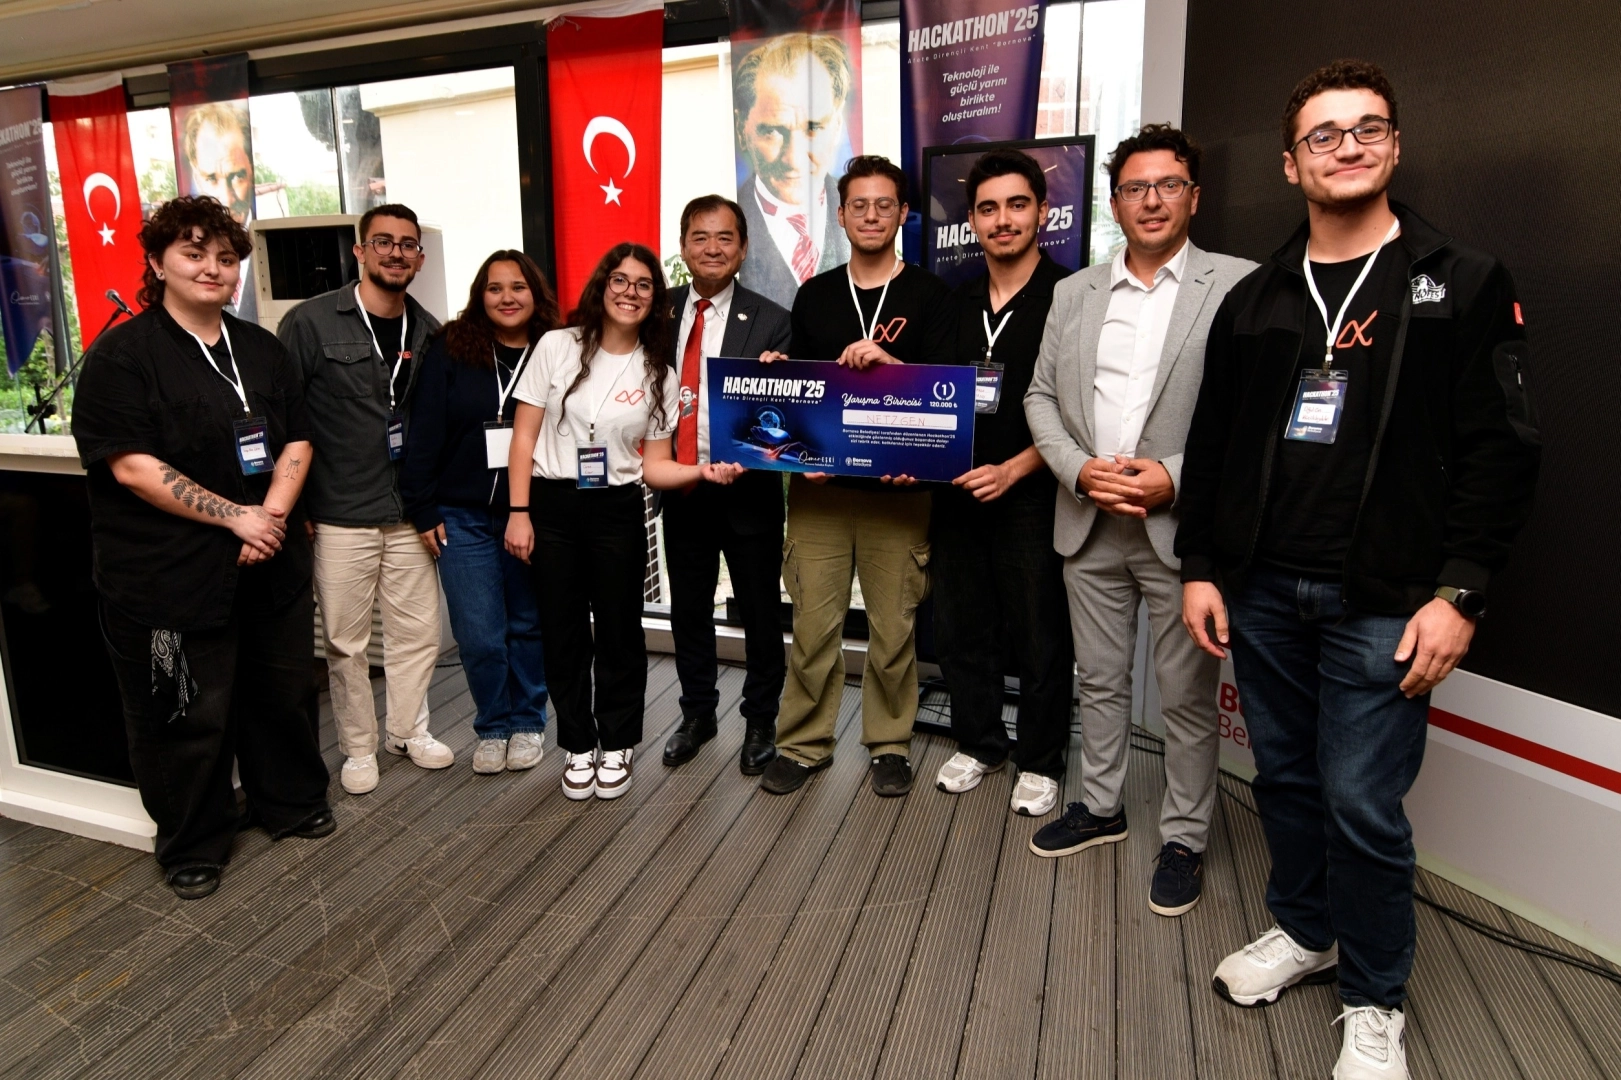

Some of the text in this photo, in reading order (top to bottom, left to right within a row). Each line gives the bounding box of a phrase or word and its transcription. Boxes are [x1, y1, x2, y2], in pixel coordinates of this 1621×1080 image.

[908, 4, 1039, 52] HACKATHON'25
[907, 55, 929, 64] Afete
[933, 48, 966, 60] Dirençli
[970, 44, 989, 52] Kent
[942, 63, 1000, 83] Teknoloji ile
[950, 77, 1007, 97] güçlü yarını
[960, 93, 995, 107] birlikte
[942, 103, 1002, 123] oluşturalım!
[0, 117, 42, 147] KATHON'25
[962, 250, 984, 259] Diren
[722, 376, 826, 398] HACKATHON'25
[841, 384, 947, 407] Yarışma Birincisi 1
